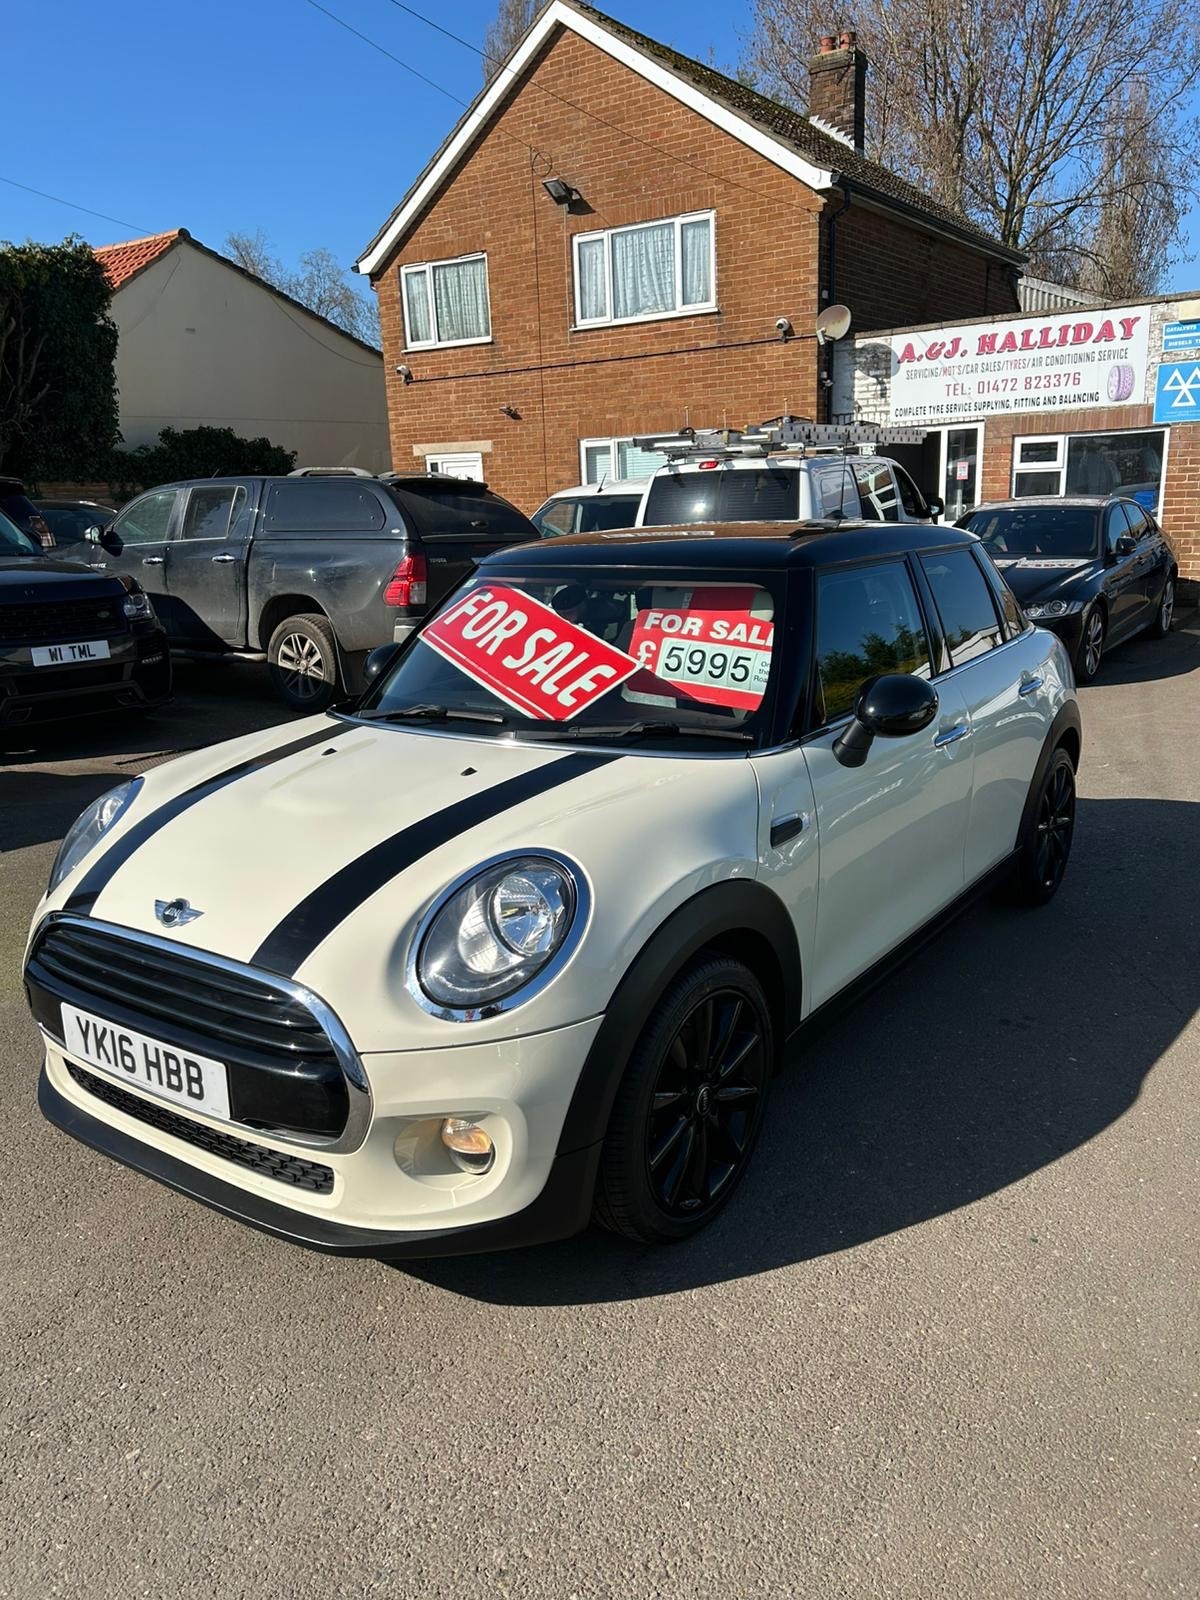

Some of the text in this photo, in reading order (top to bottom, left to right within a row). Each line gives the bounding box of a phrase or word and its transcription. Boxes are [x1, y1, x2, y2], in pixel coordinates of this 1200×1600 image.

[976, 316, 1141, 355] HALLIDAY
[1045, 351, 1096, 367] CONDITIONING
[1098, 347, 1129, 362] SERVICE
[945, 372, 1081, 397] TEL: 01472 823376
[895, 391, 1100, 418] COMPLETE TYRE SERVICE SUPPLYING, FITTING AND BALANCING
[643, 612, 703, 636] FOR
[69, 644, 96, 660] TML
[444, 591, 617, 707] FOR SALE
[664, 646, 752, 682] 5995
[76, 1015, 205, 1101] YK16 HBB
